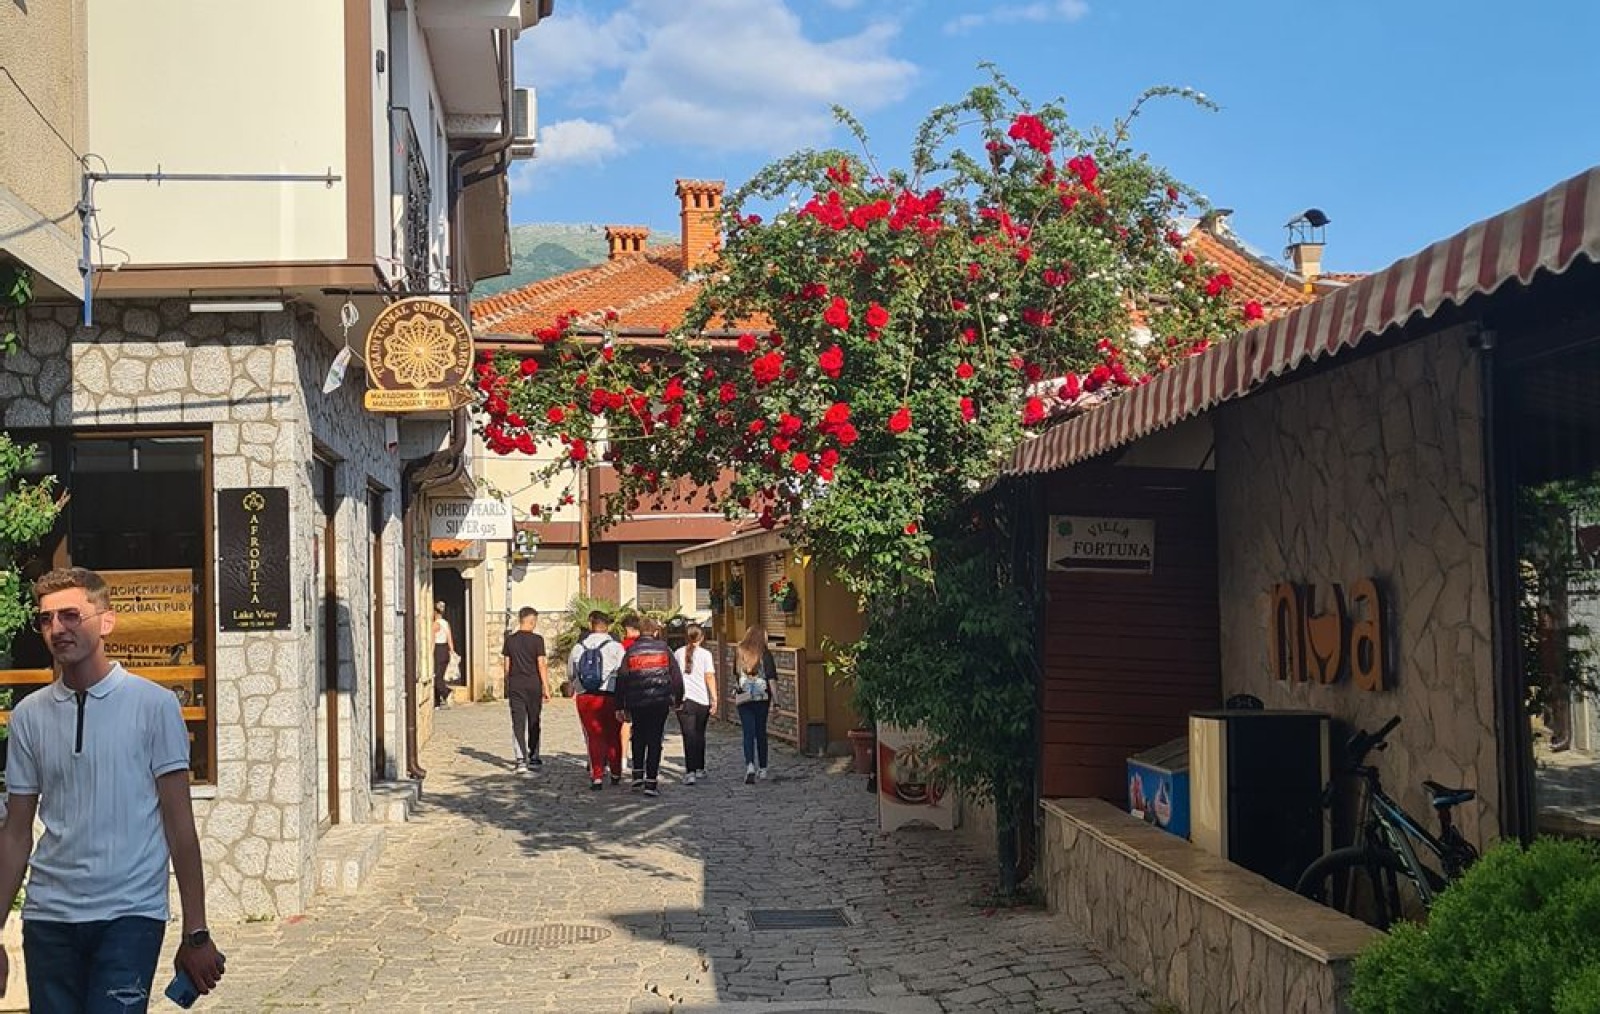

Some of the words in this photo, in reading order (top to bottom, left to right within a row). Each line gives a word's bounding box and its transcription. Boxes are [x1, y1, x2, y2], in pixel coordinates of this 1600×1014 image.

[413, 303, 449, 319] OHRID
[435, 502, 468, 517] OHRID
[471, 502, 507, 516] PEARLS
[446, 520, 479, 534] SILVER
[1087, 521, 1129, 539] VILLA
[1073, 541, 1150, 557] FORTUNA
[250, 514, 260, 604] AFRODITA
[110, 585, 158, 596] ДОНСКИ
[233, 610, 254, 620] Lake
[256, 609, 278, 619] View
[104, 643, 149, 653] ДОНСКИ
